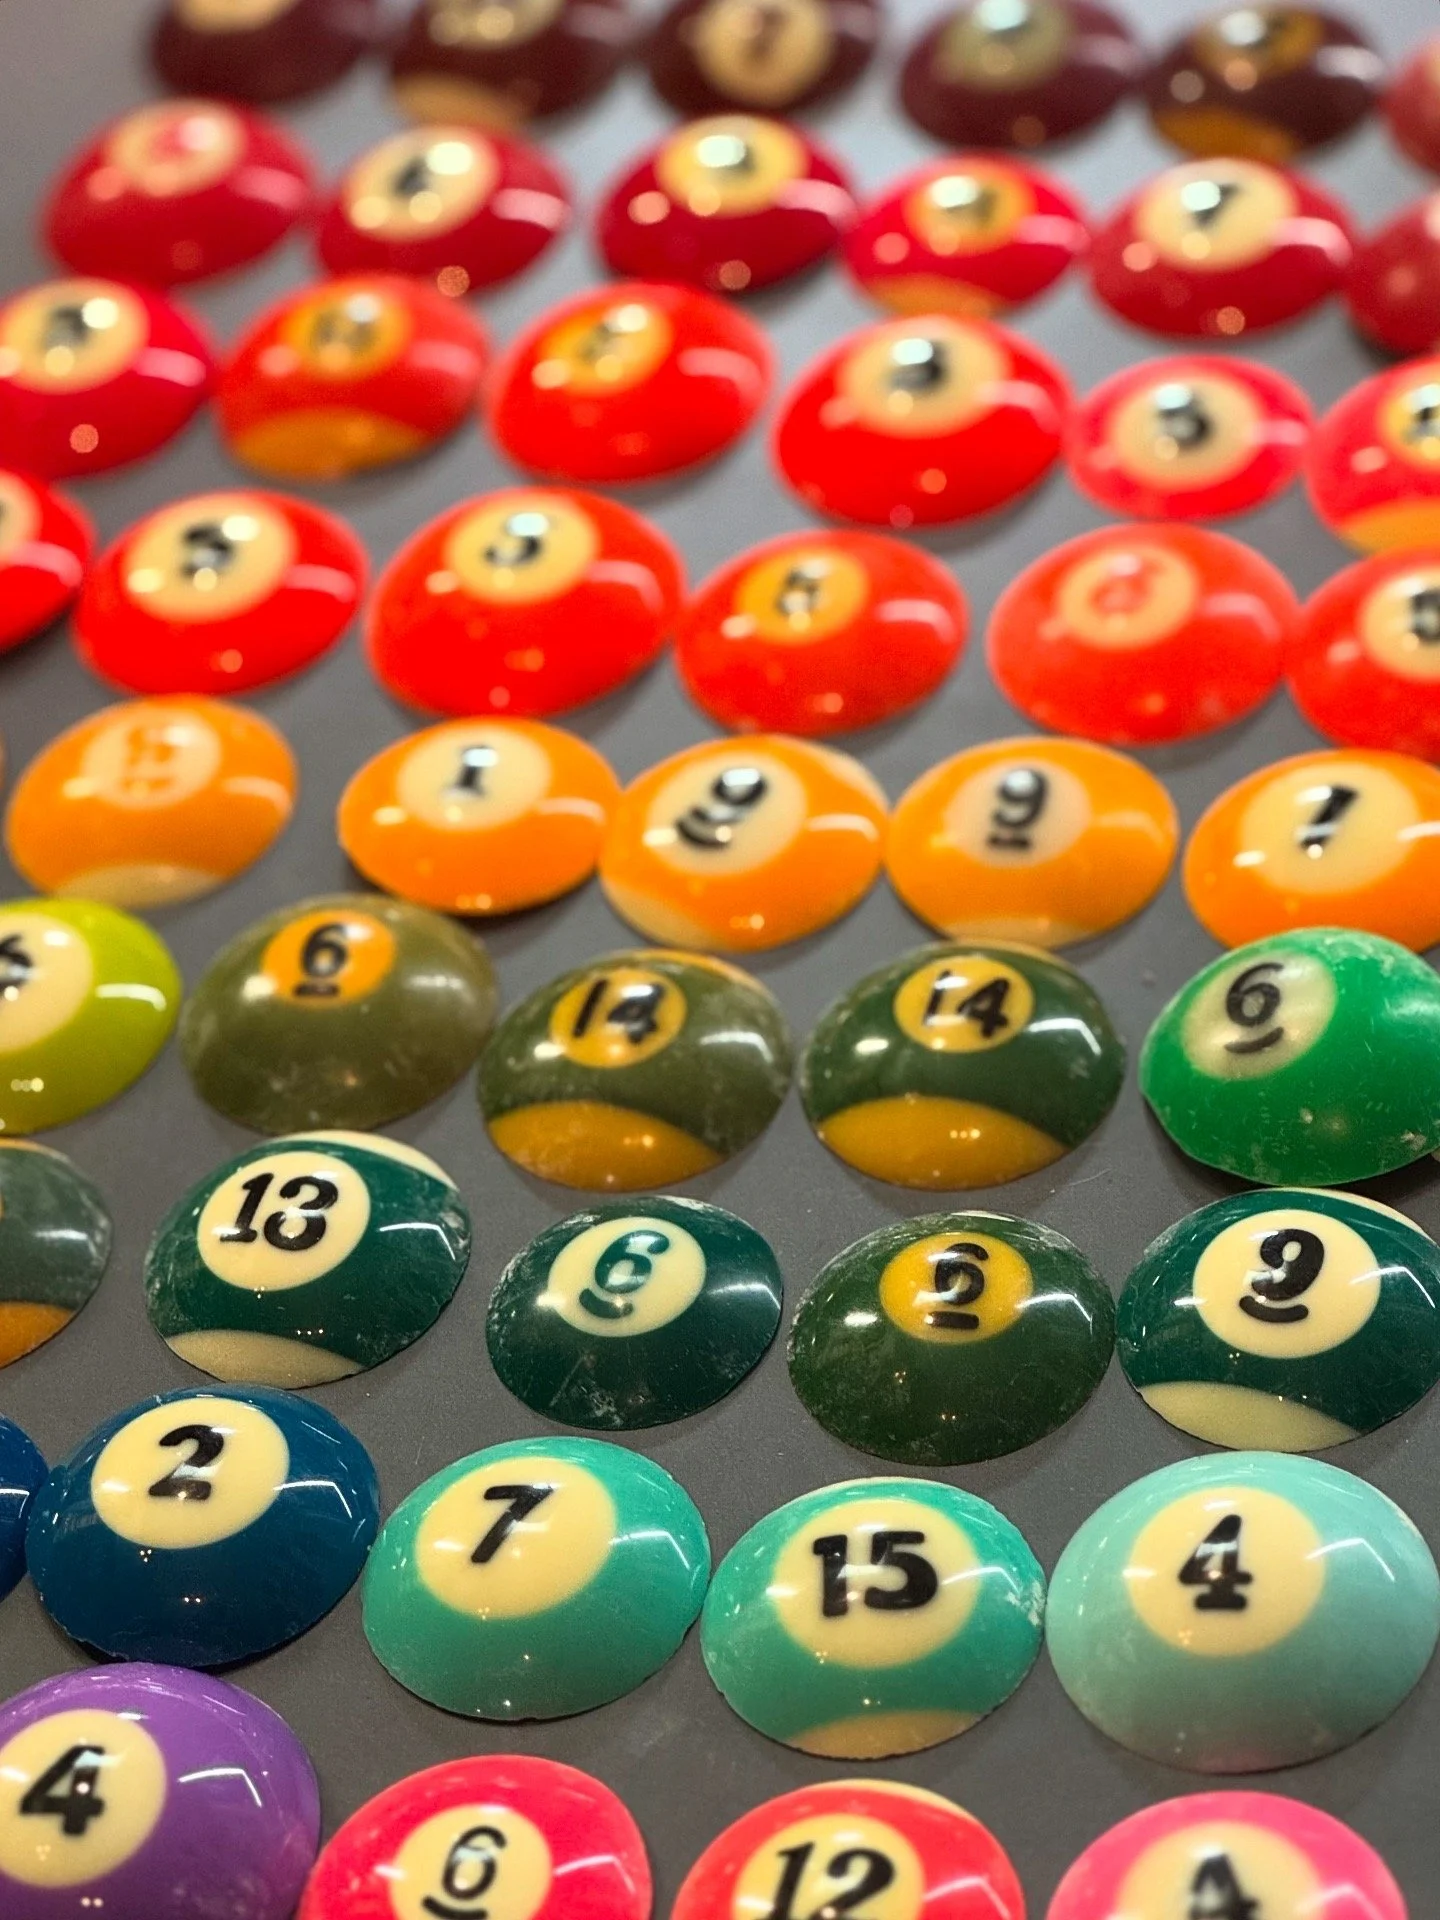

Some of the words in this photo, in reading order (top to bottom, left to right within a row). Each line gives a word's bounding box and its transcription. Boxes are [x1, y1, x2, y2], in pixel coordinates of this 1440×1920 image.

[675, 767, 768, 851] 9
[986, 766, 1048, 850] 9
[293, 923, 349, 997] 6
[572, 977, 665, 1045] 14
[921, 968, 1010, 1040] 14
[1223, 961, 1284, 1055] 6
[218, 1171, 340, 1252] 13
[577, 1229, 671, 1320] 6
[925, 1241, 989, 1331] 6
[1237, 1228, 1326, 1324] 9
[148, 1423, 225, 1501] 2
[470, 1483, 556, 1565] 7
[1176, 1513, 1255, 1612] 4
[811, 1528, 940, 1619] 15
[19, 1743, 107, 1836] 4
[421, 1825, 508, 1920] 6
[766, 1840, 896, 1920] 12
[1186, 1850, 1262, 1920] 4
